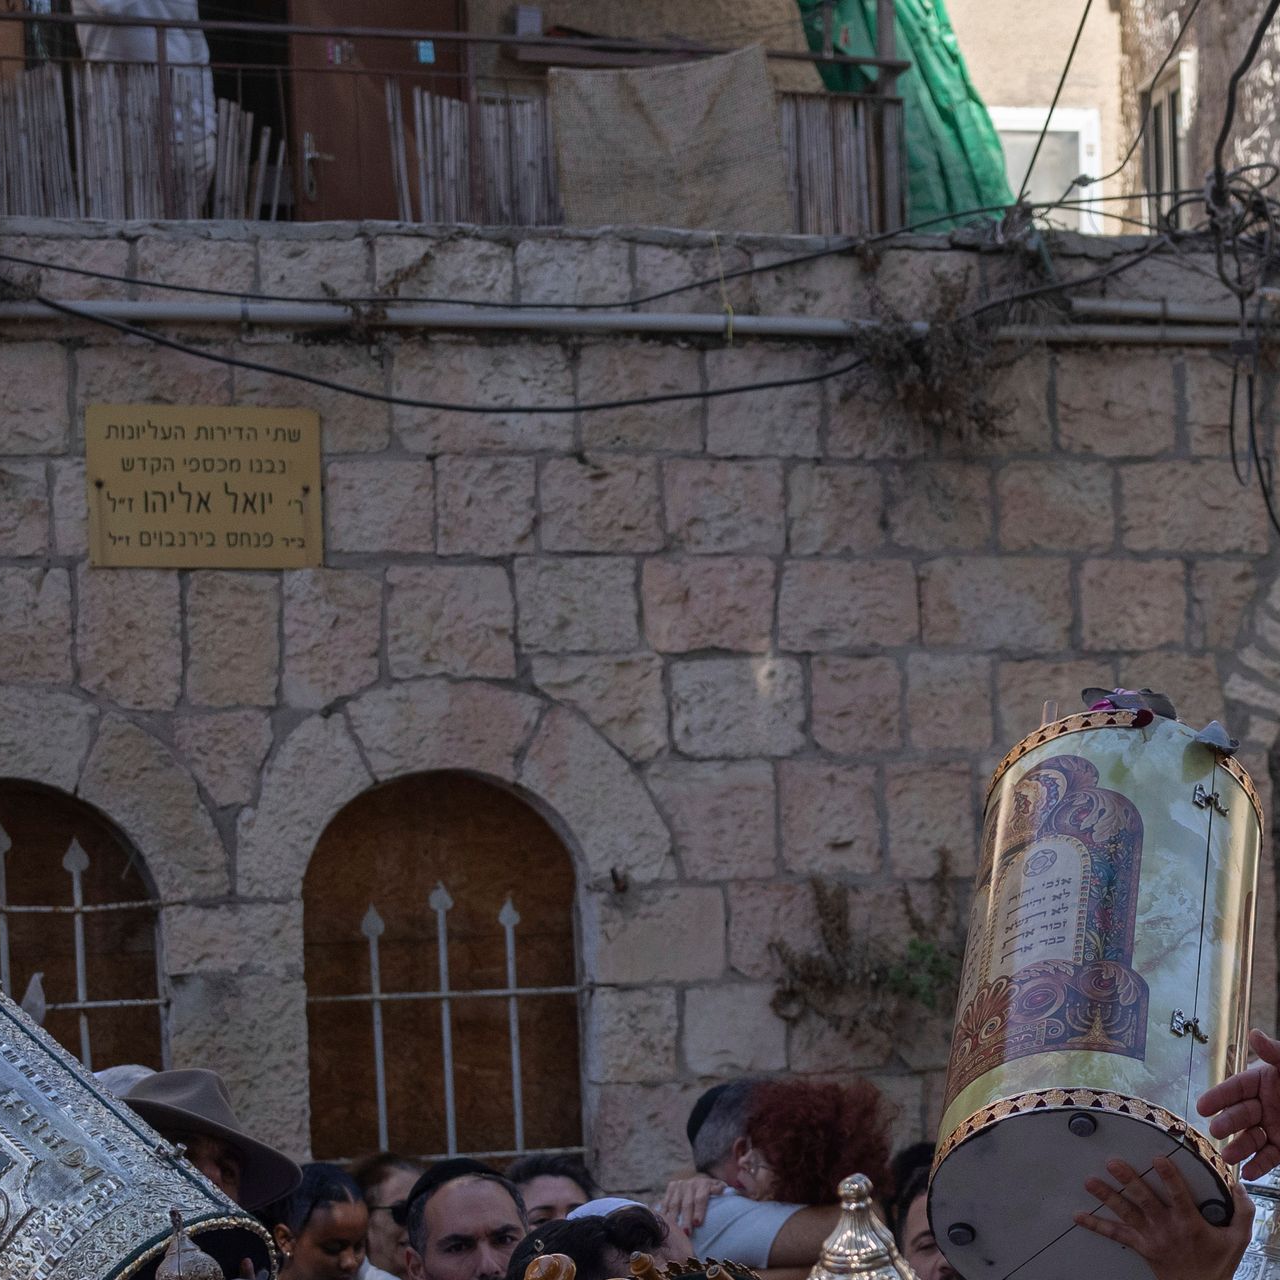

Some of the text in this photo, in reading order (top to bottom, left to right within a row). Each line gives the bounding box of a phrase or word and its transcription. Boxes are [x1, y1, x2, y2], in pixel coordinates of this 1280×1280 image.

[105, 420, 301, 443] שתי הדירות העליונות
[121, 457, 286, 475] נבנו מכספי הקדש
[144, 481, 211, 514] אליהו
[224, 482, 273, 515] יואל
[140, 531, 216, 547] בירנבוים
[225, 532, 274, 548] פנחס
[1042, 878, 1072, 889] אנכי
[1052, 889, 1070, 901] לא
[1051, 903, 1069, 916] לא
[1041, 920, 1067, 930] זכור
[1039, 936, 1065, 945] כבד
